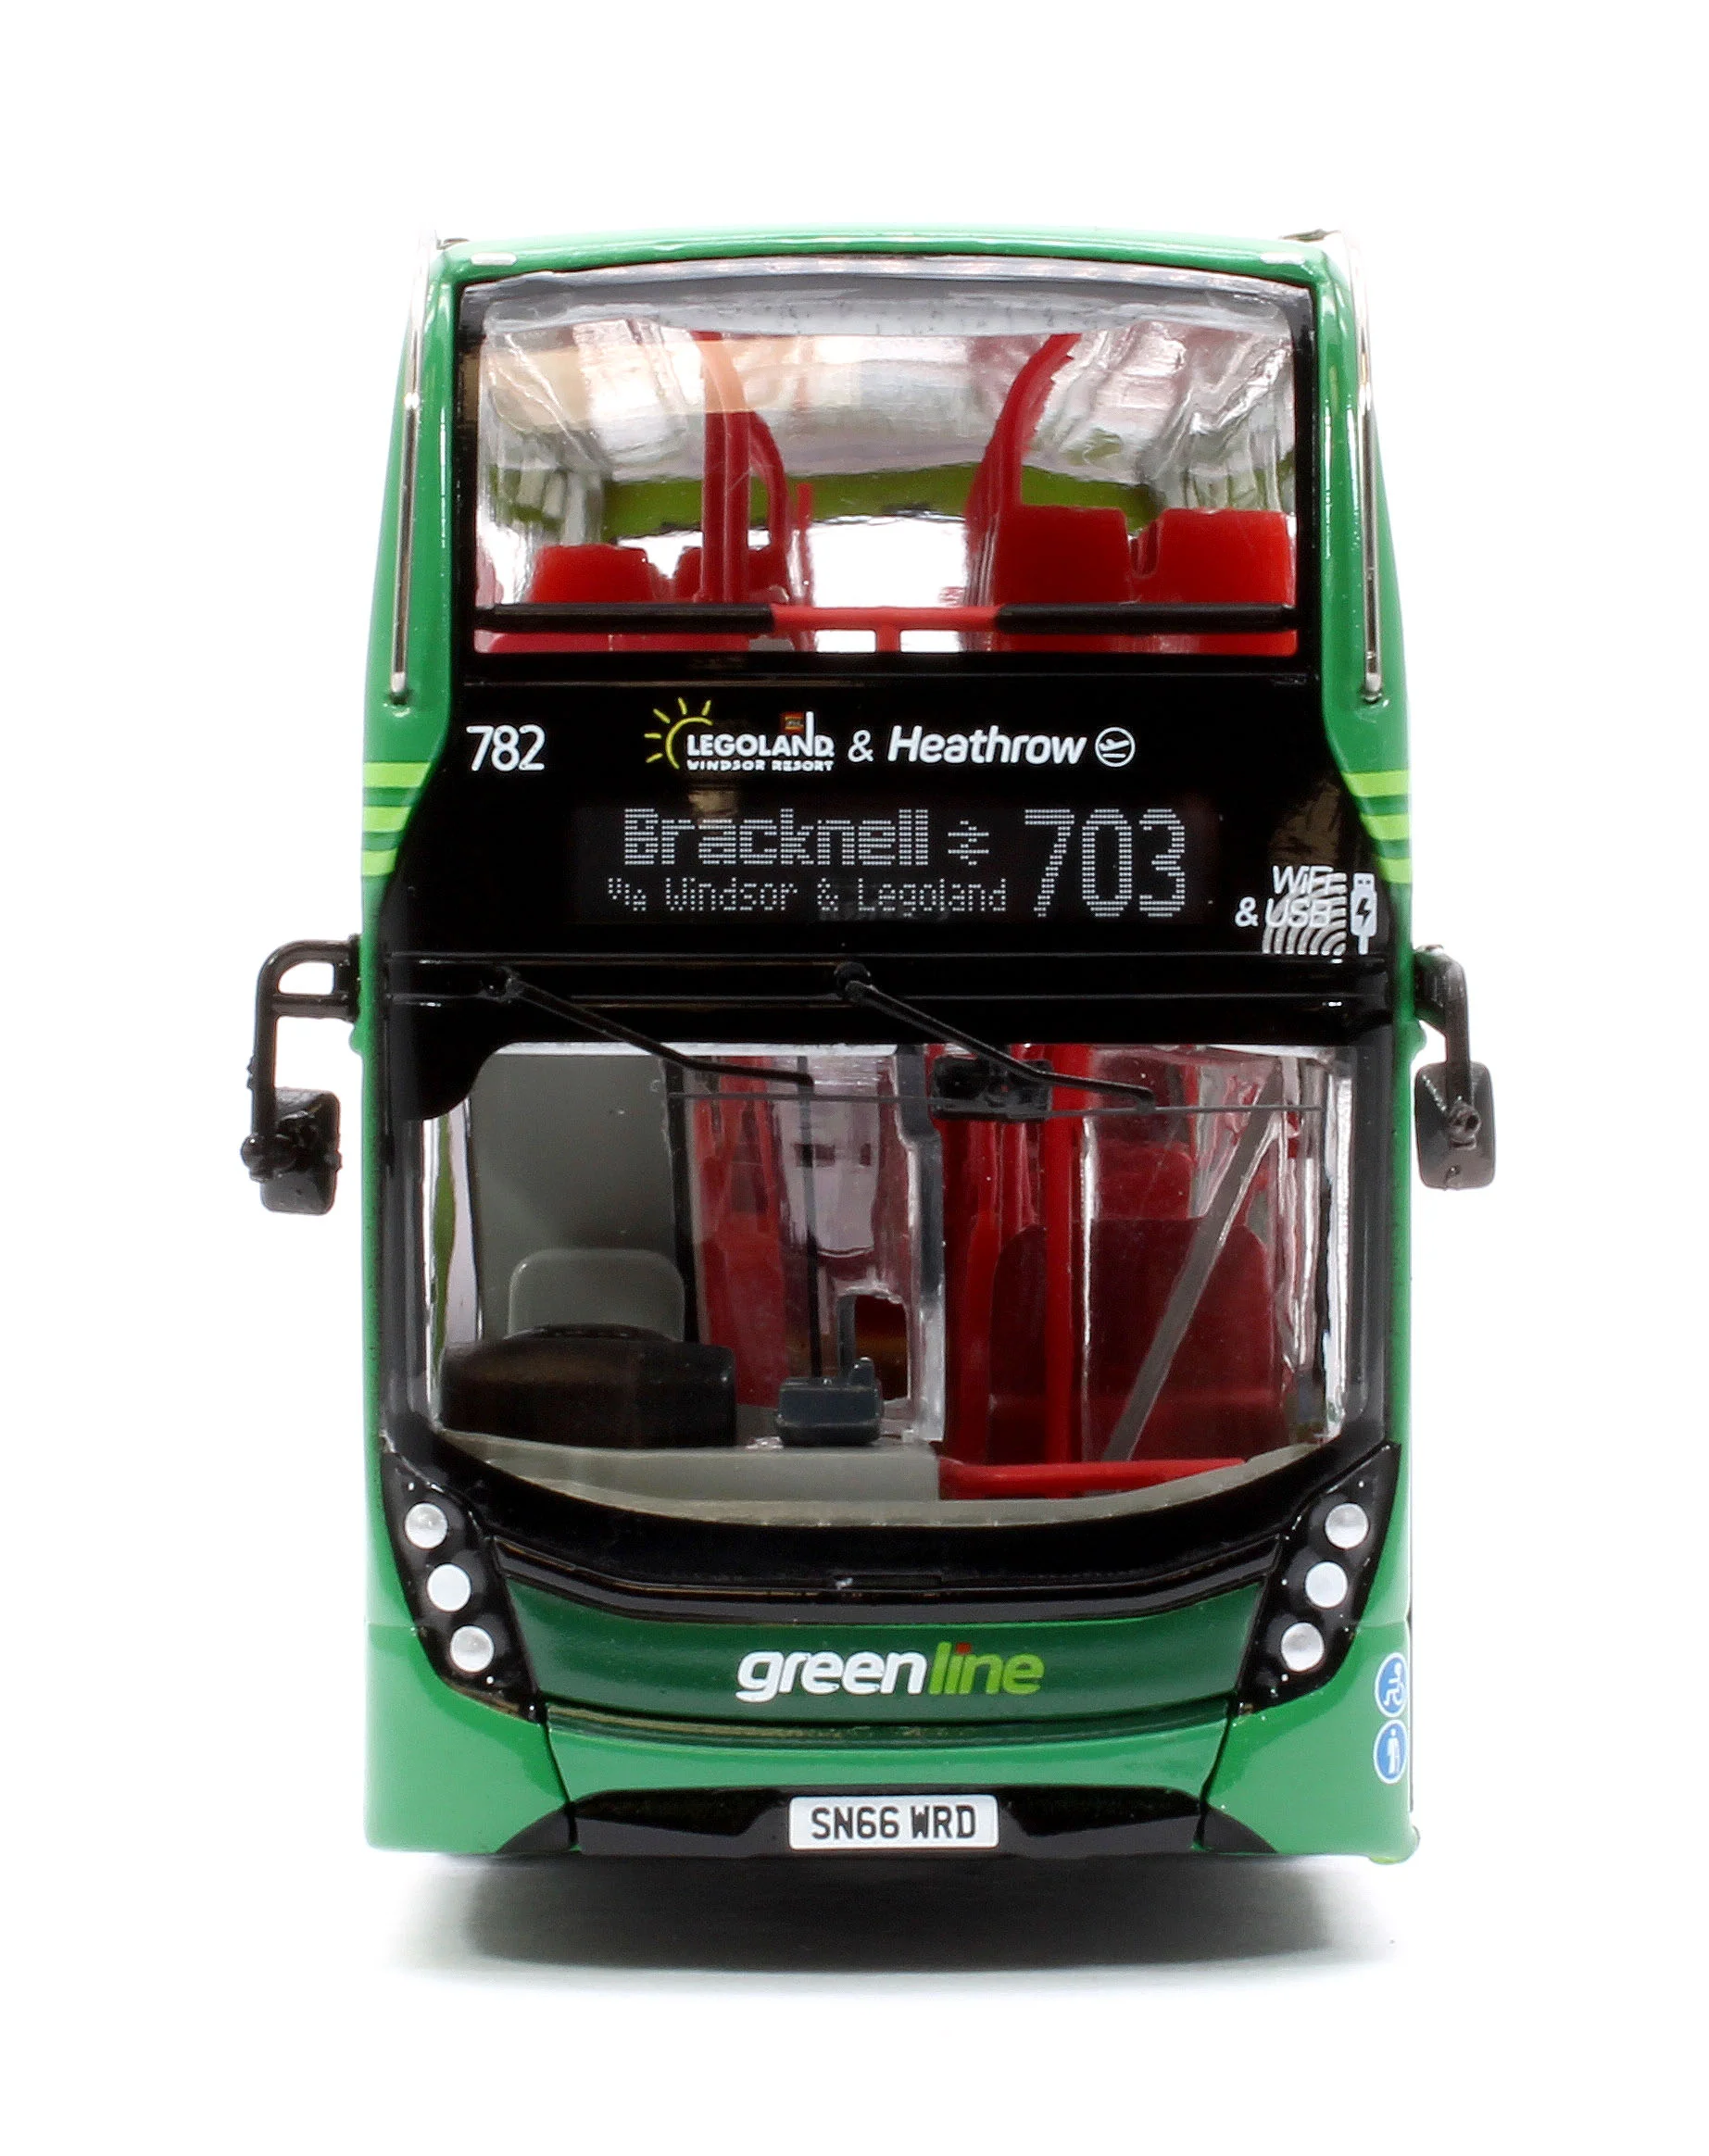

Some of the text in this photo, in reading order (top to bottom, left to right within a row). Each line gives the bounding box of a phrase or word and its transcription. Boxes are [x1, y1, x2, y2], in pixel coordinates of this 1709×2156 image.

[466, 725, 547, 771] 782
[687, 711, 1087, 765] LEGOLAND & Heathrow
[686, 759, 835, 771] WINDSOR RESORT
[624, 808, 929, 866] Bracknell
[1024, 808, 1186, 917] 703
[665, 877, 798, 911] Windsor
[816, 877, 839, 911] &
[858, 877, 1007, 918] Legoland
[1235, 896, 1332, 927] & USB
[735, 1641, 1045, 1703] greenline
[811, 1806, 976, 1839] SN66 WRD
